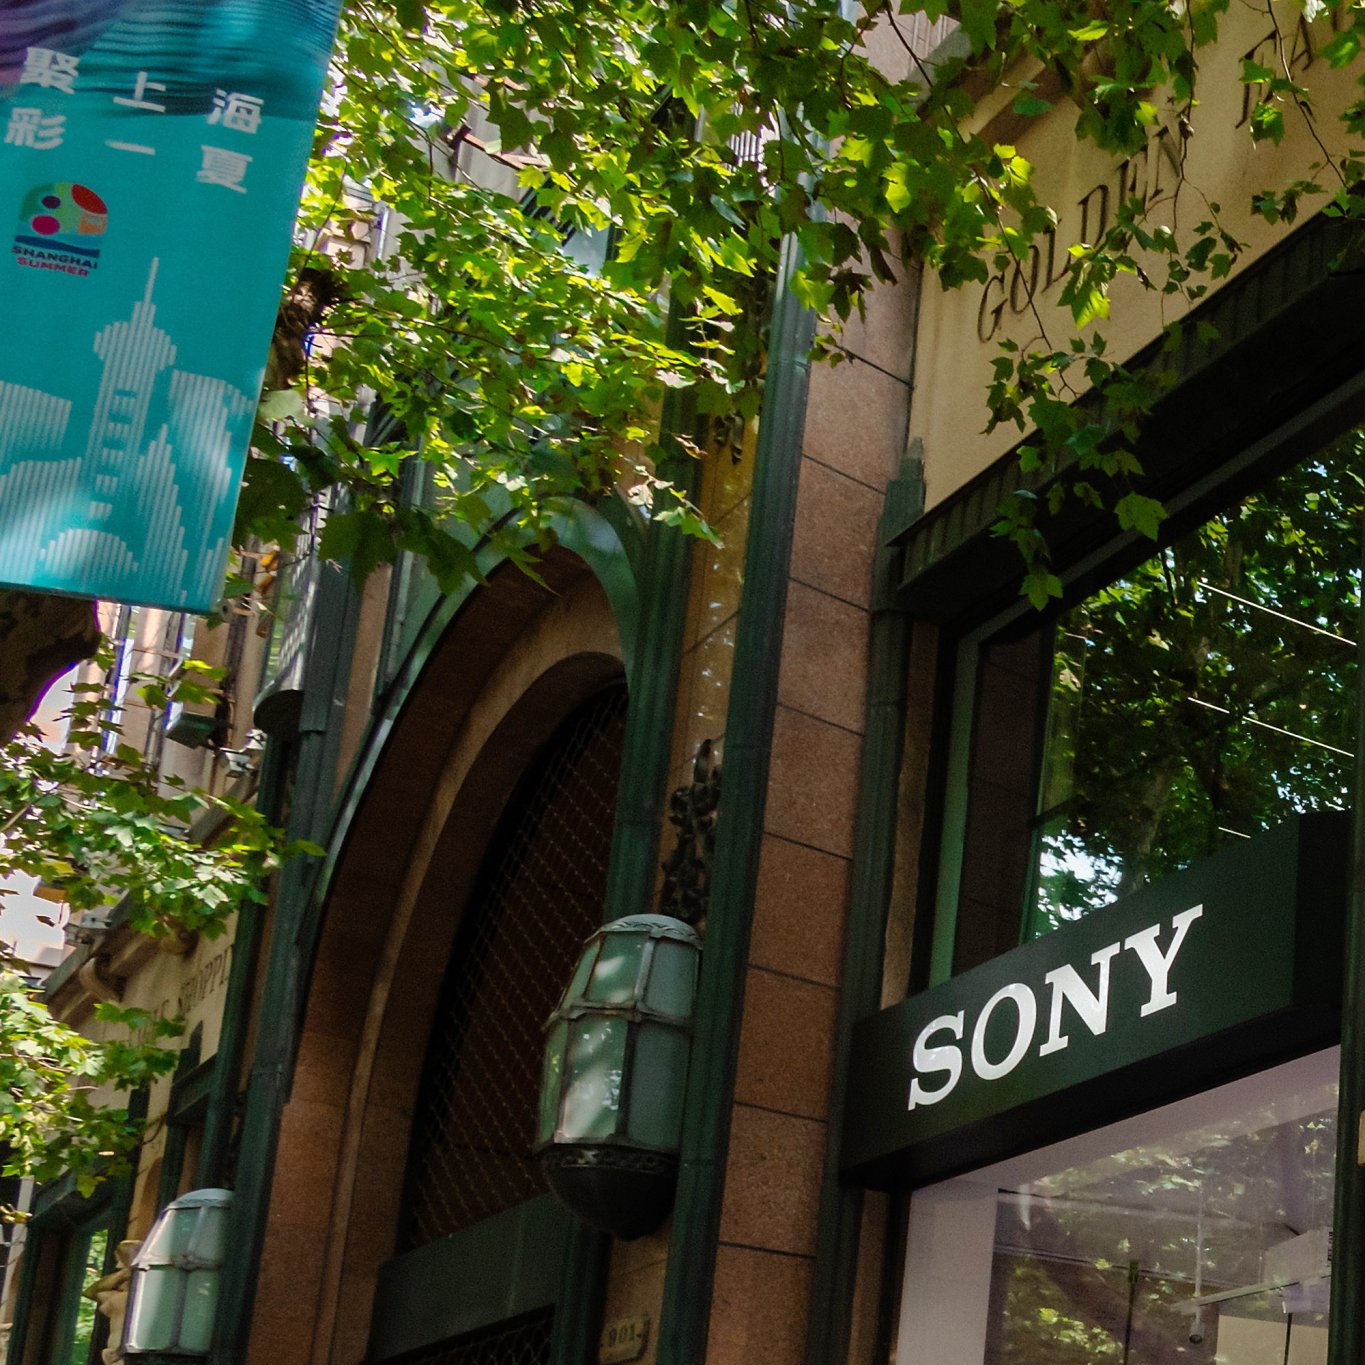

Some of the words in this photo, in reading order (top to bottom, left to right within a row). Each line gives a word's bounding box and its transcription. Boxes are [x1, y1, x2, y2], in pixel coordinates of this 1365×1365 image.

[12, 246, 97, 269] SHANGHAI
[17, 256, 89, 277] SUMMER
[908, 904, 1203, 1111] SONY
